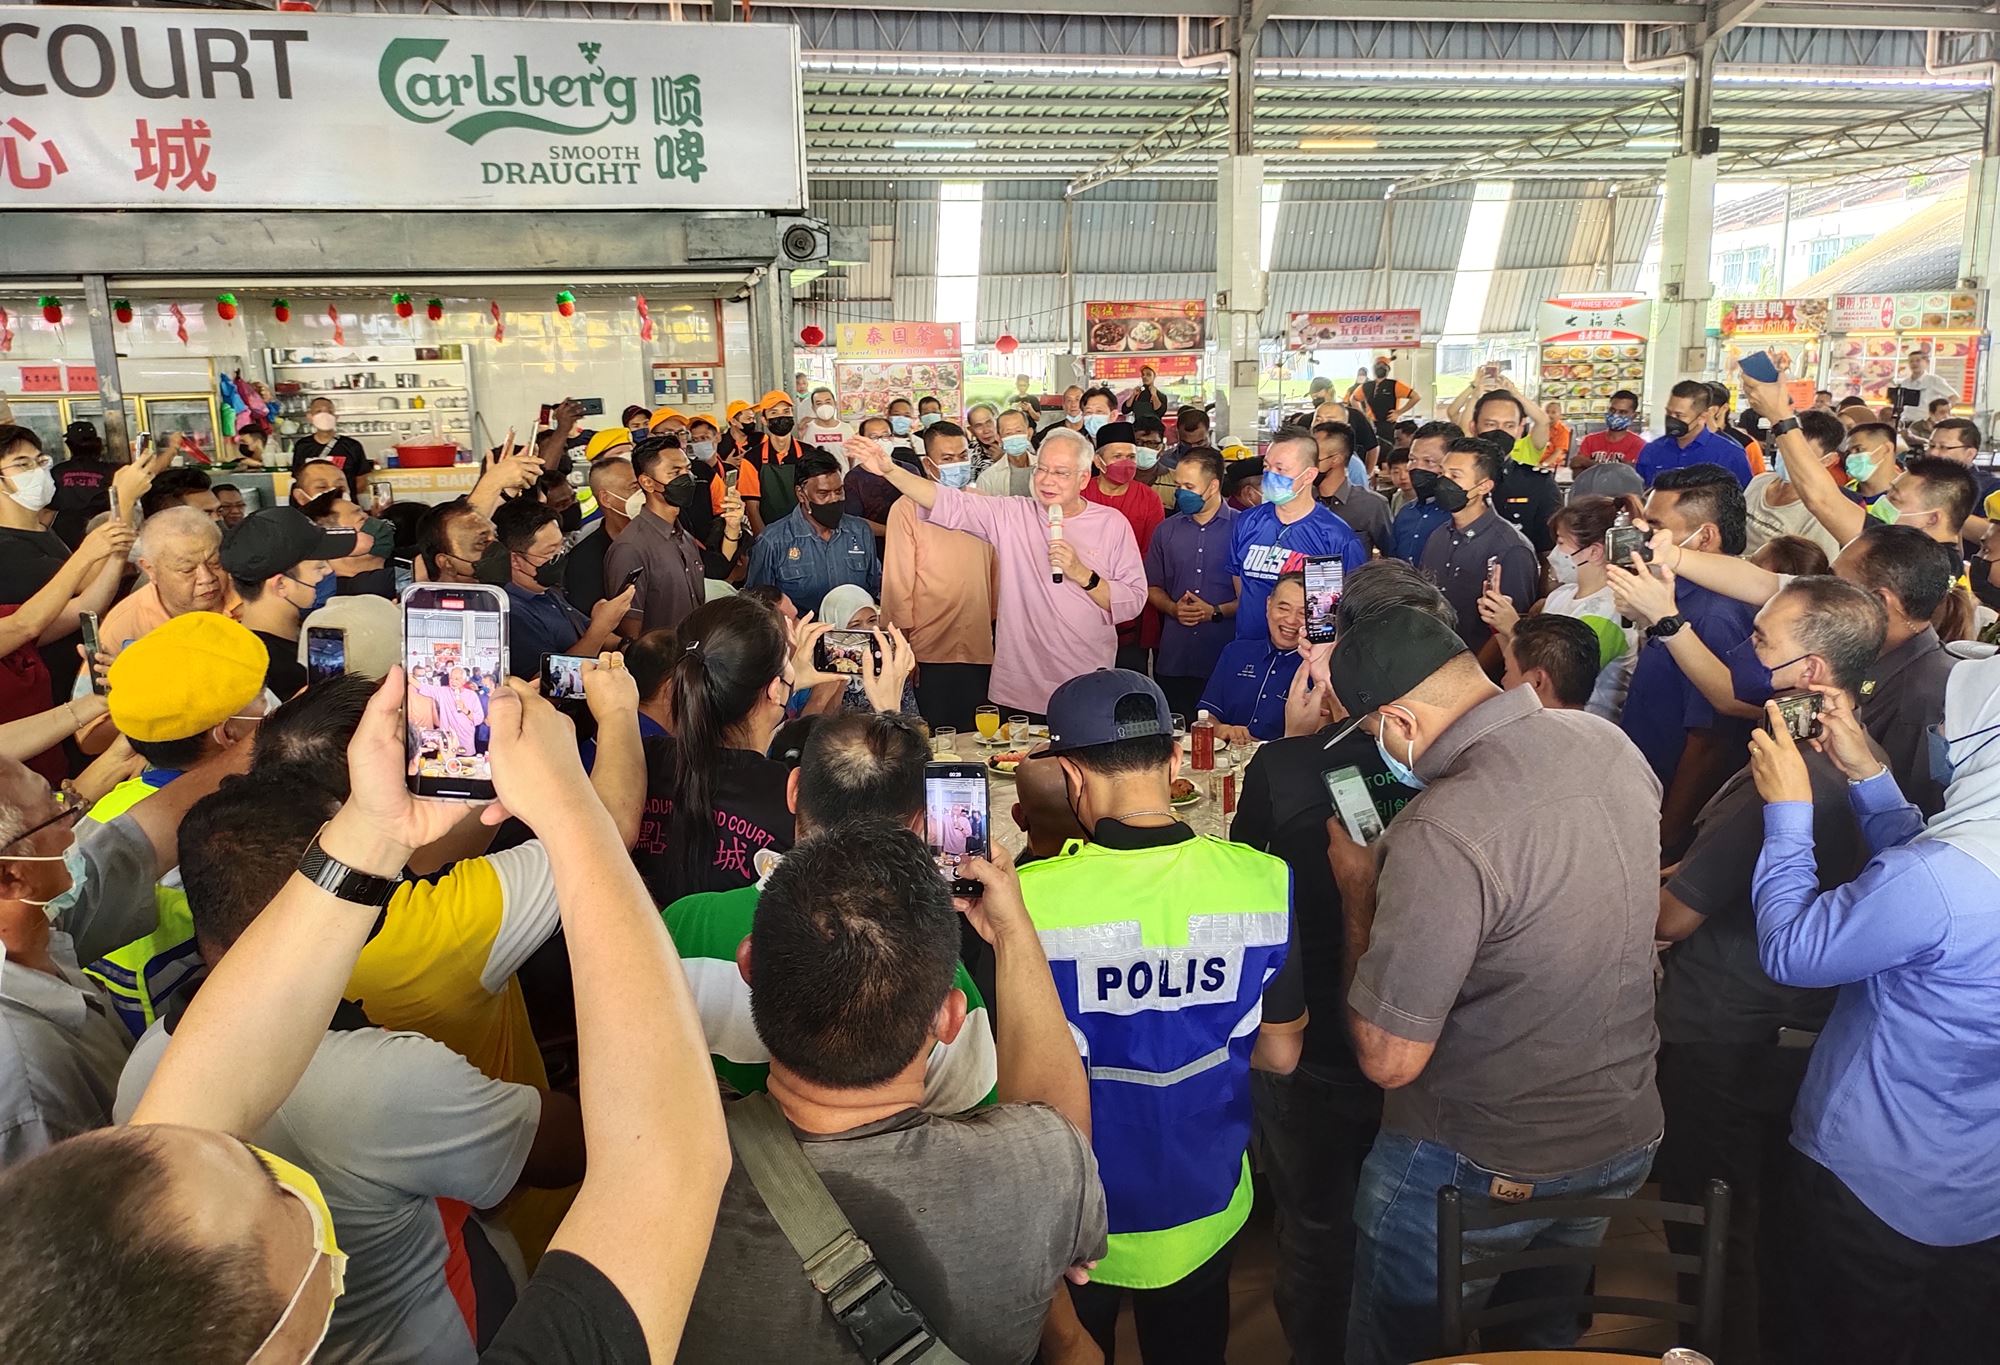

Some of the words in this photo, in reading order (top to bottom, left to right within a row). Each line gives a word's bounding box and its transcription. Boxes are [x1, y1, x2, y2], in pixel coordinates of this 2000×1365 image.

[0, 22, 309, 99] COURT
[378, 37, 637, 126] Carlsberg
[549, 145, 640, 160] SMOOTH
[481, 162, 641, 185] DRAUGHT
[1338, 315, 1383, 324] LORBAK
[728, 815, 776, 848] COURT
[712, 836, 751, 880] 城
[1097, 957, 1227, 1001] POLIS
[1497, 1183, 1526, 1200] Lois
